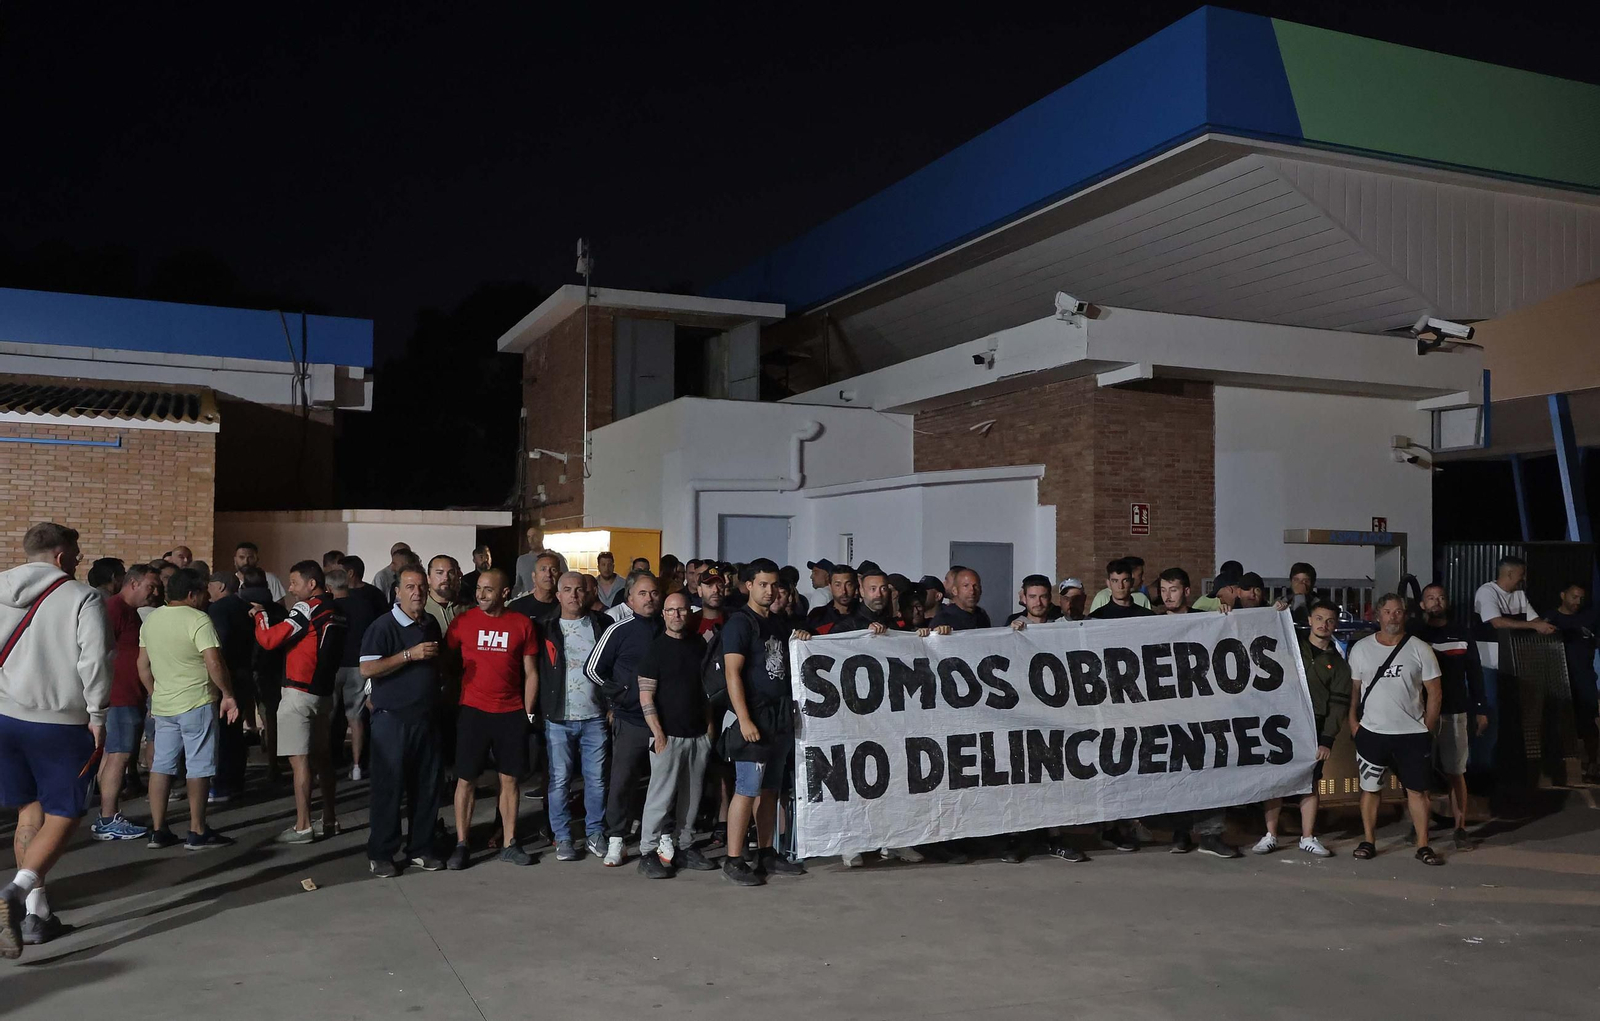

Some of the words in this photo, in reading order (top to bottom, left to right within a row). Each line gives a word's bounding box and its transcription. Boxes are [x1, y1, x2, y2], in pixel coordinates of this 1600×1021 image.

[477, 630, 508, 648] HH
[800, 654, 1019, 719] SOMOS
[1028, 635, 1285, 707] OBREROS
[805, 740, 891, 803] NO
[905, 715, 1294, 795] DELINCUENTES
